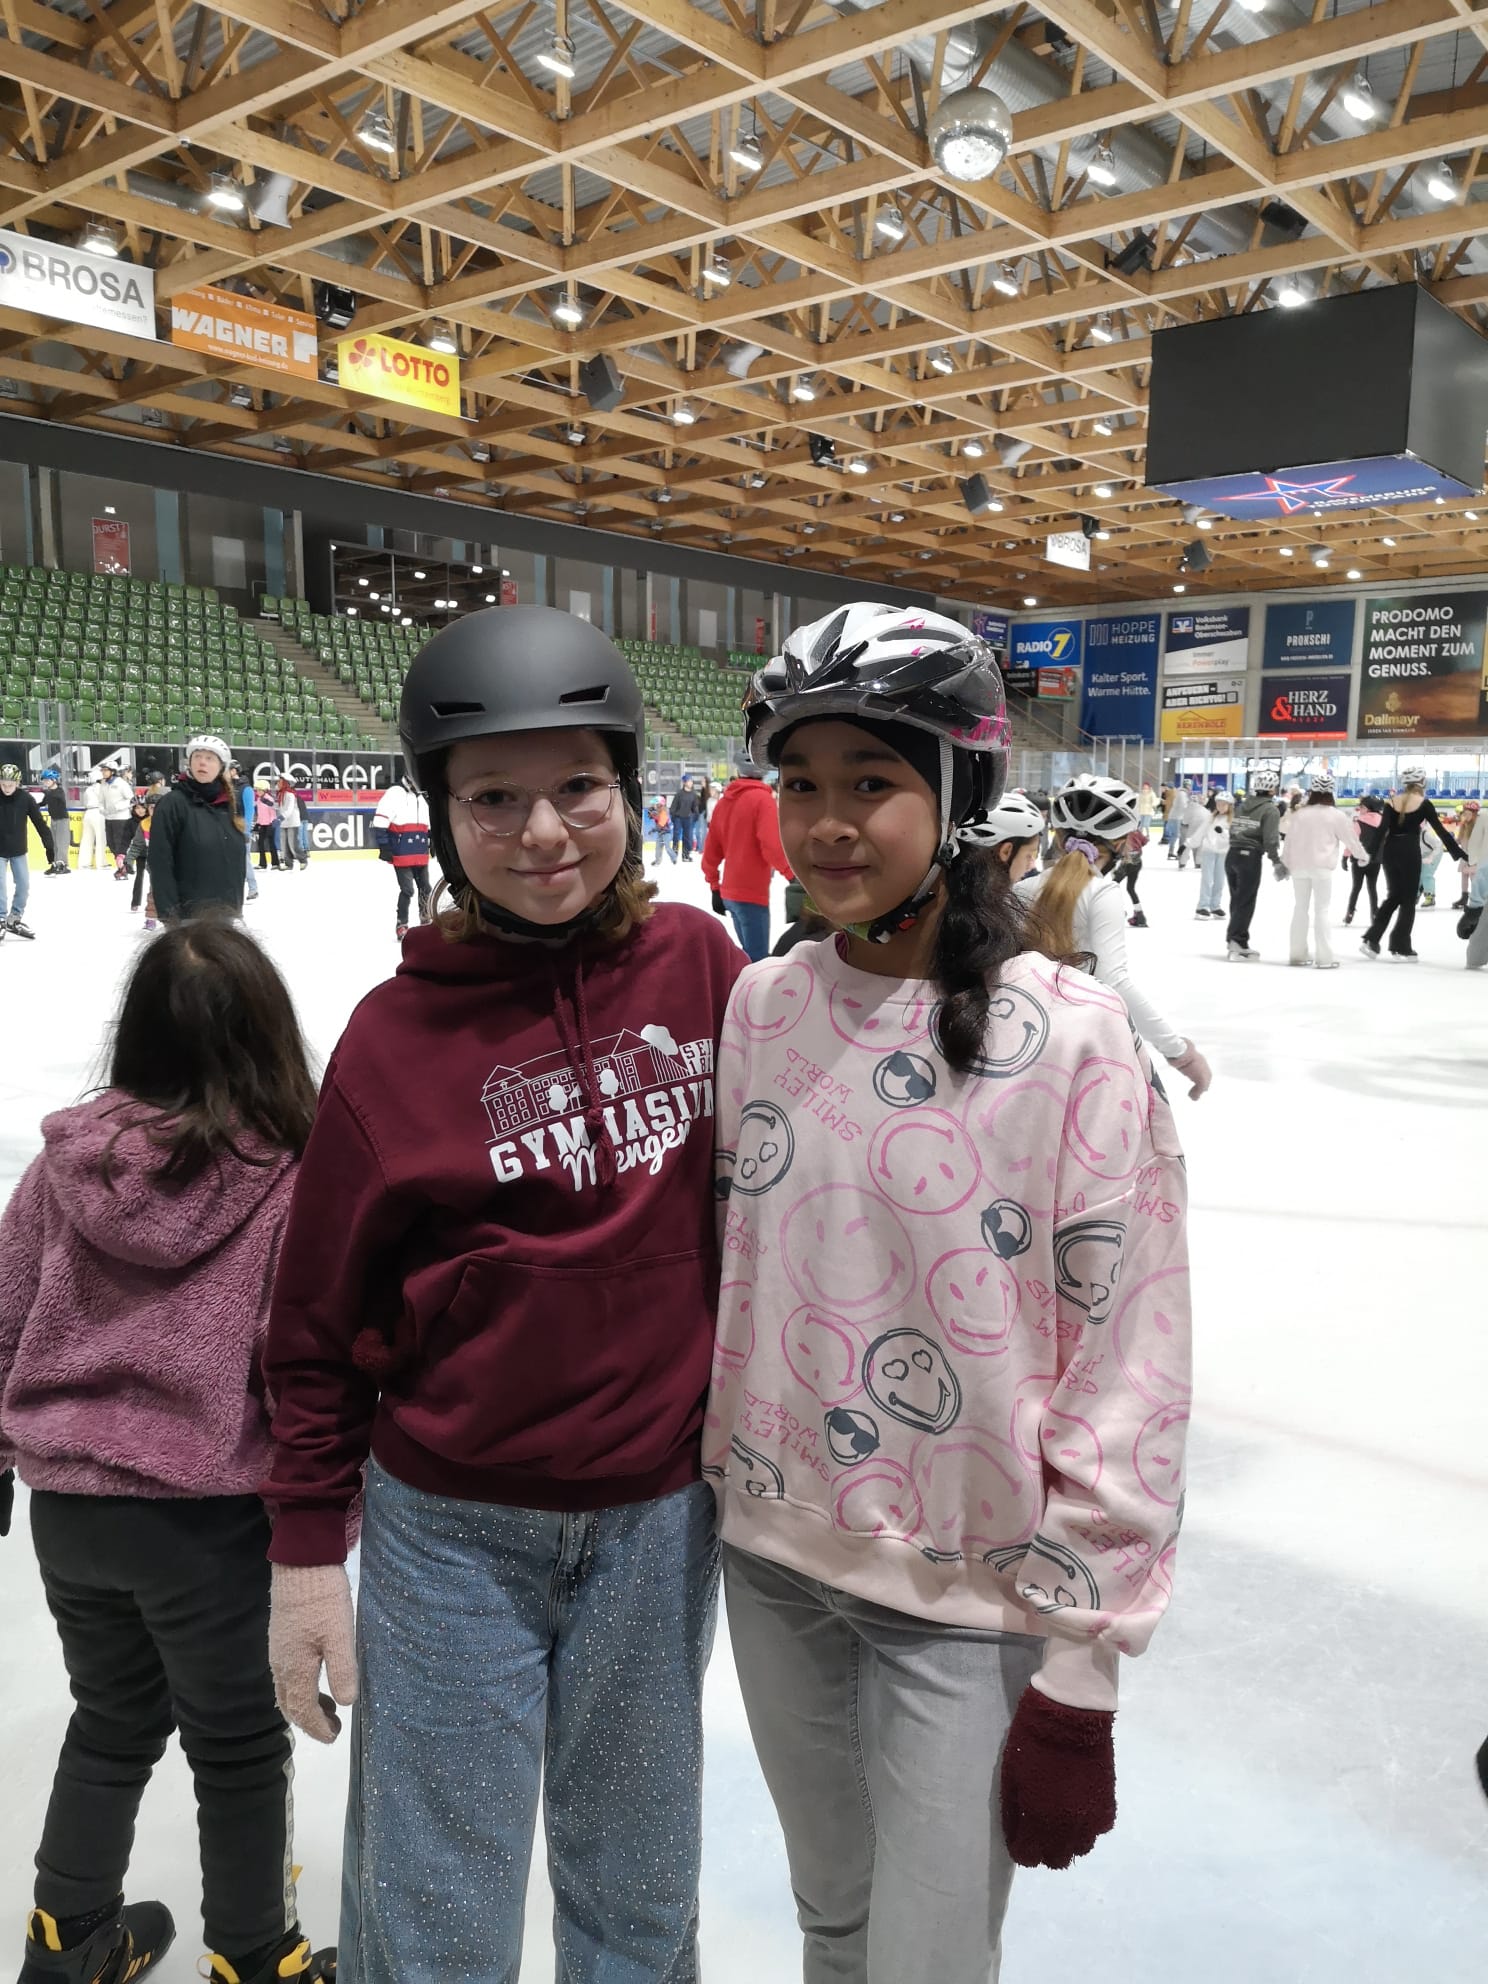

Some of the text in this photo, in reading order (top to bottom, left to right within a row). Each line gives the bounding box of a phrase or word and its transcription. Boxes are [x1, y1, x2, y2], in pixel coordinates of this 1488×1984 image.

[22, 250, 145, 309] BROSA
[171, 305, 289, 359] WAGNER
[380, 347, 450, 388] LOTTO
[1372, 606, 1454, 625] PRODOMO
[1111, 620, 1156, 635] HOPPE
[1370, 624, 1462, 642] MACHT DEN
[1016, 633, 1072, 657] RADIO 7
[1111, 633, 1156, 645] HEIZUNG
[1368, 642, 1476, 660] MOMENT ZUM
[1091, 671, 1149, 684] Kalter Sport.
[1368, 663, 1432, 678] GENUSS.
[1288, 690, 1329, 704] HERZ
[1293, 703, 1337, 717] HAND
[1364, 714, 1420, 727] Dallmayr
[253, 753, 383, 789] ebner
[786, 1048, 854, 1104] WORLD
[774, 1067, 863, 1142] SMILEY
